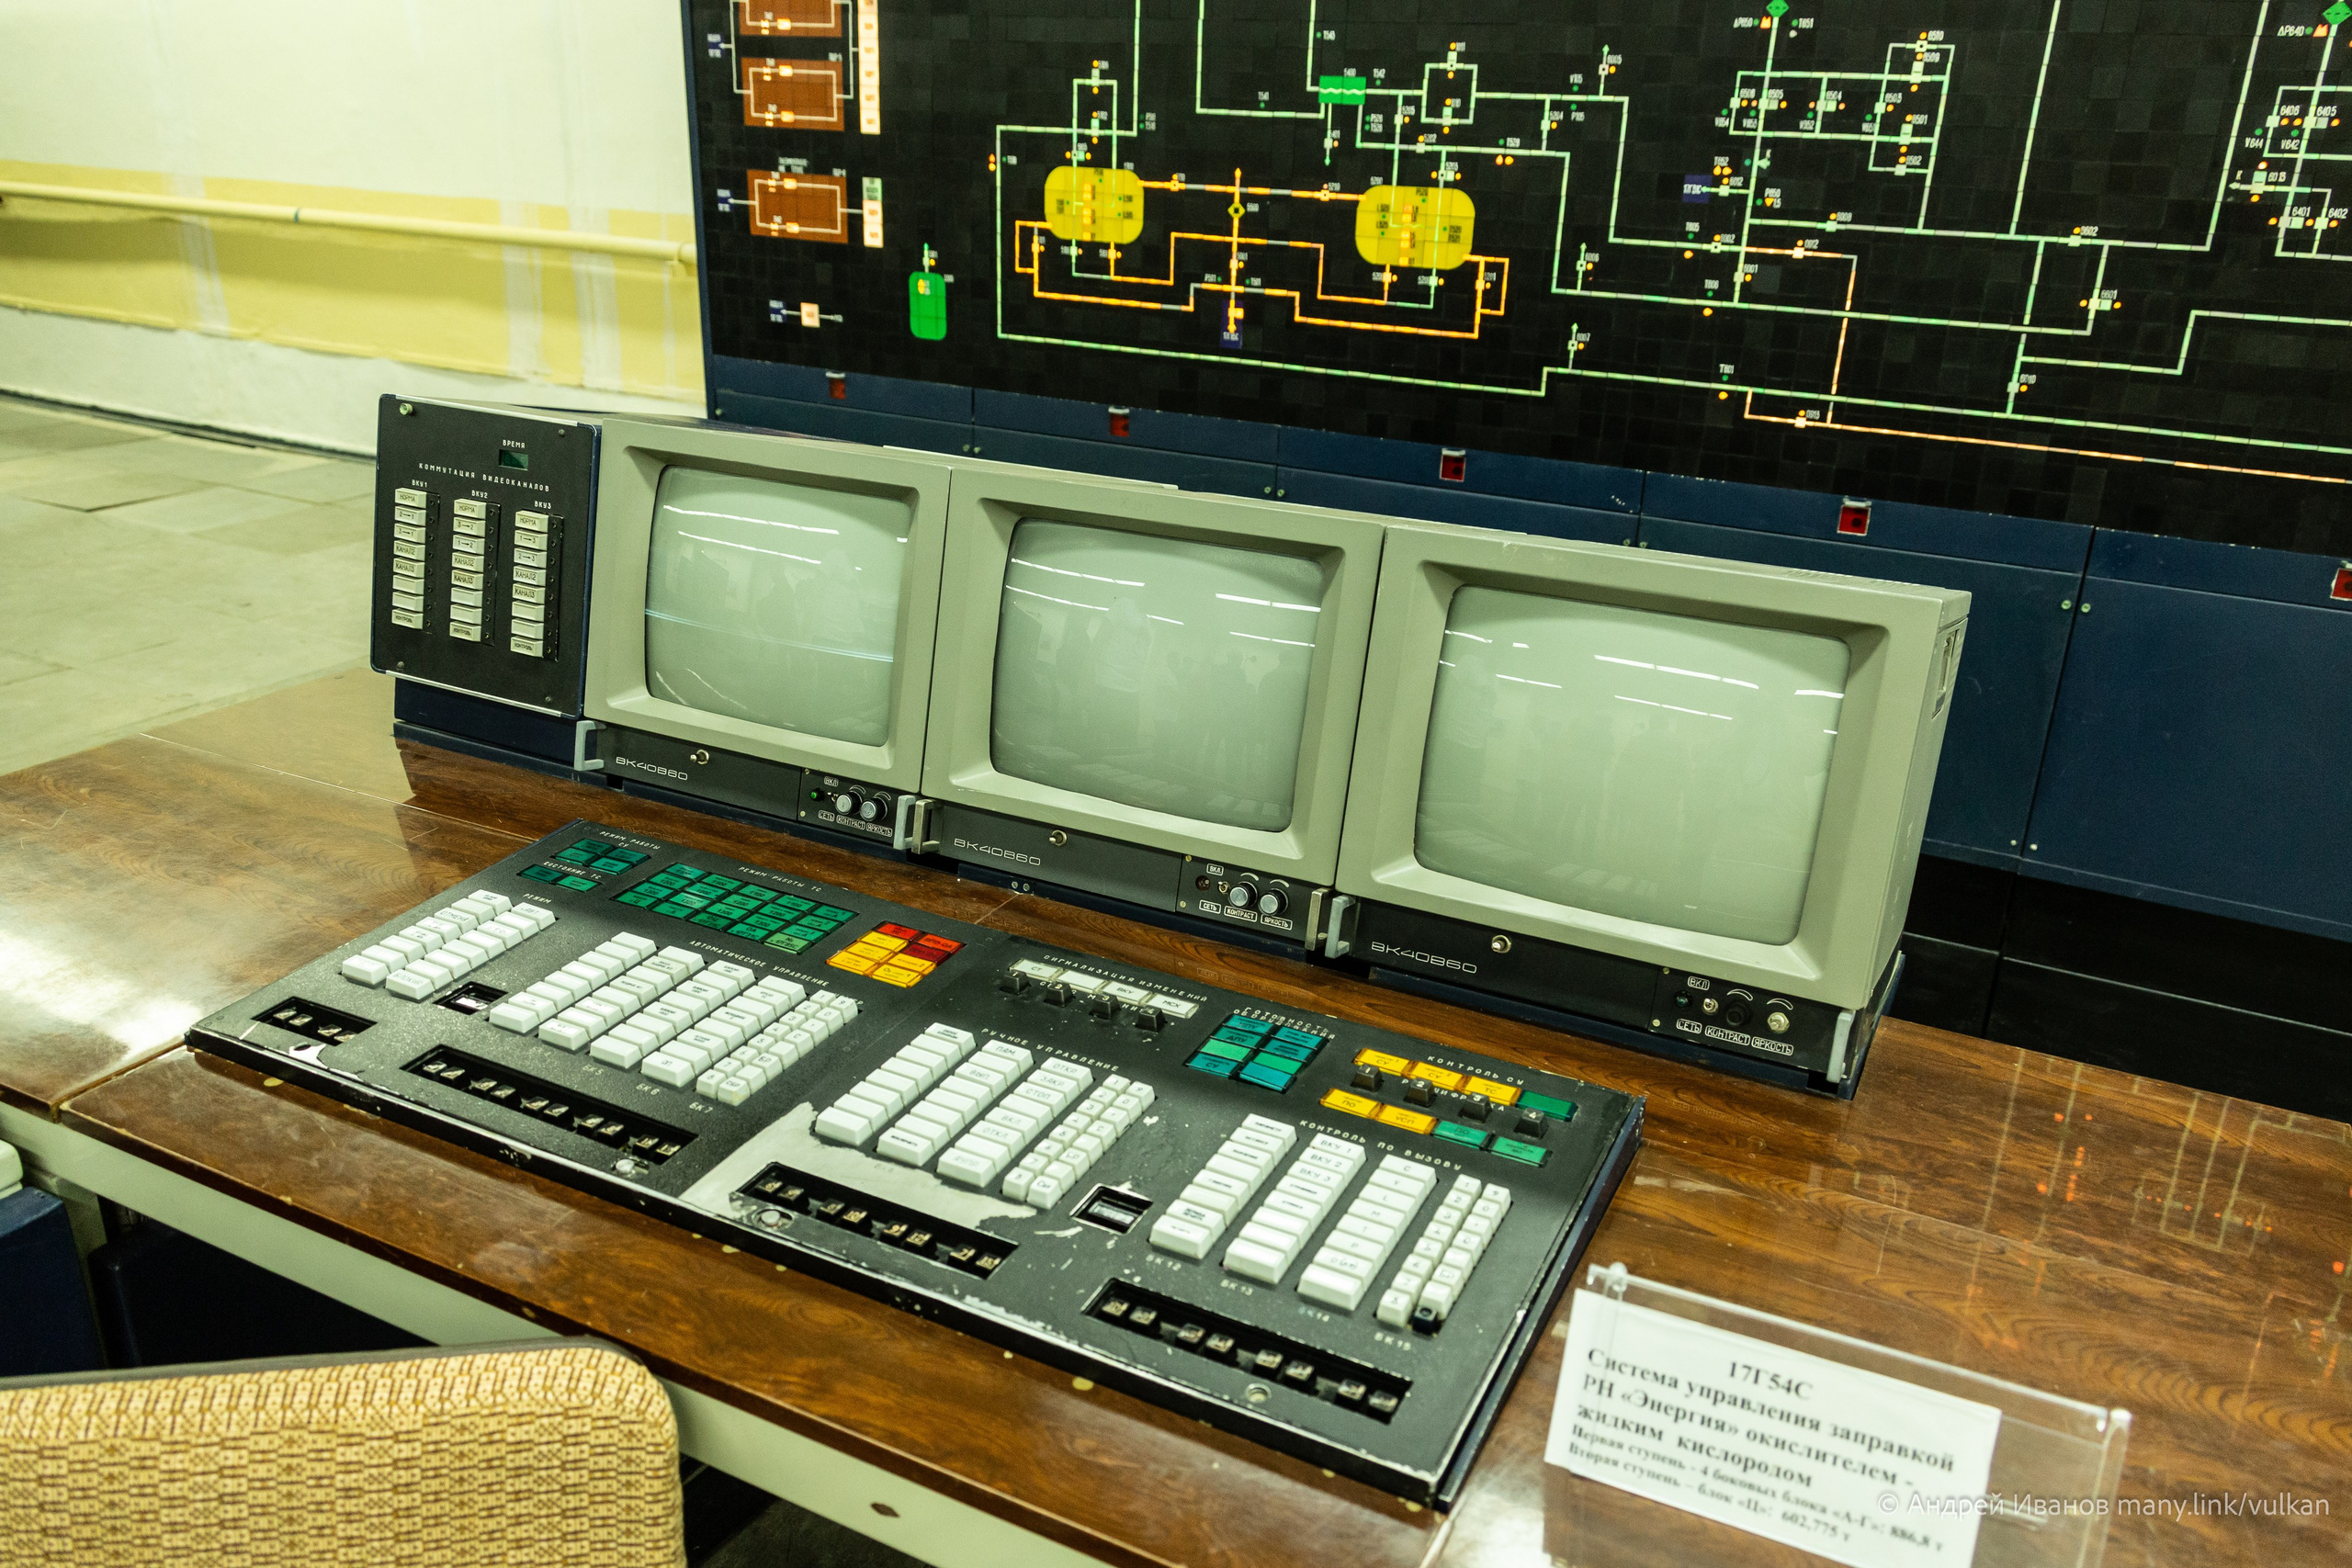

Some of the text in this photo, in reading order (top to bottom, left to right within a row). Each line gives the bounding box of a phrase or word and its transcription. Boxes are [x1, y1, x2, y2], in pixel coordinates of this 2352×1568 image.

[503, 439, 526, 449] ВРЕМЯ
[418, 462, 549, 492] КОММУТАЦИЯ ВИДЕОКАНАЛОВ
[739, 866, 768, 877] РЕЖИМ
[772, 875, 805, 887] РАБОТЫ
[522, 893, 552, 904] РЕЖИМ
[1203, 902, 1217, 911] СЕТЬ
[1227, 908, 1255, 919] КОНТРАСТ
[1264, 917, 1289, 928] ЯРКОСТЬ
[690, 940, 766, 968] АВТОМАТИЧЕСКОЕ
[773, 965, 830, 987] УПРАВЛЕНИЕ
[1043, 954, 1208, 1002] СИГНАЛИЗАЦИЯ ИЗМЕНЕНИЙ
[1690, 978, 1708, 988] ВКЛ
[1679, 1021, 1701, 1032] СЕТЬ
[1707, 1027, 1748, 1043] КОНТРАСТ
[981, 1028, 1028, 1046] РУЧНОЕ
[1036, 1043, 1119, 1072] УПРАВЛЕНИЕ
[1754, 1038, 1792, 1054] ЯРКОСТЬ
[1427, 1055, 1524, 1086] КОНТРОЛЬ СУ
[1299, 1120, 1462, 1171] КОНТРОЛЬ ПО ВЫЗОВУ
[1728, 1360, 1814, 1400] 17Г54С
[1588, 1348, 1955, 1472] Система управления заправкой
[1583, 1372, 1616, 1399] РН
[1621, 1389, 1739, 1435] «Энергия»
[1746, 1428, 1897, 1485] окислителем
[1577, 1404, 1813, 1488] жидким кислородом
[1572, 1424, 1624, 1450] Первая
[1627, 1443, 1686, 1471] ступень
[1701, 1464, 1709, 1477] 4
[1713, 1467, 1776, 1498] боковых
[1781, 1491, 1828, 1515] блока
[1568, 1441, 1620, 1468] Вторая
[1623, 1461, 1680, 1488] ступень
[1698, 1483, 1733, 1508] блок
[1781, 1511, 1838, 1538] 602,775
